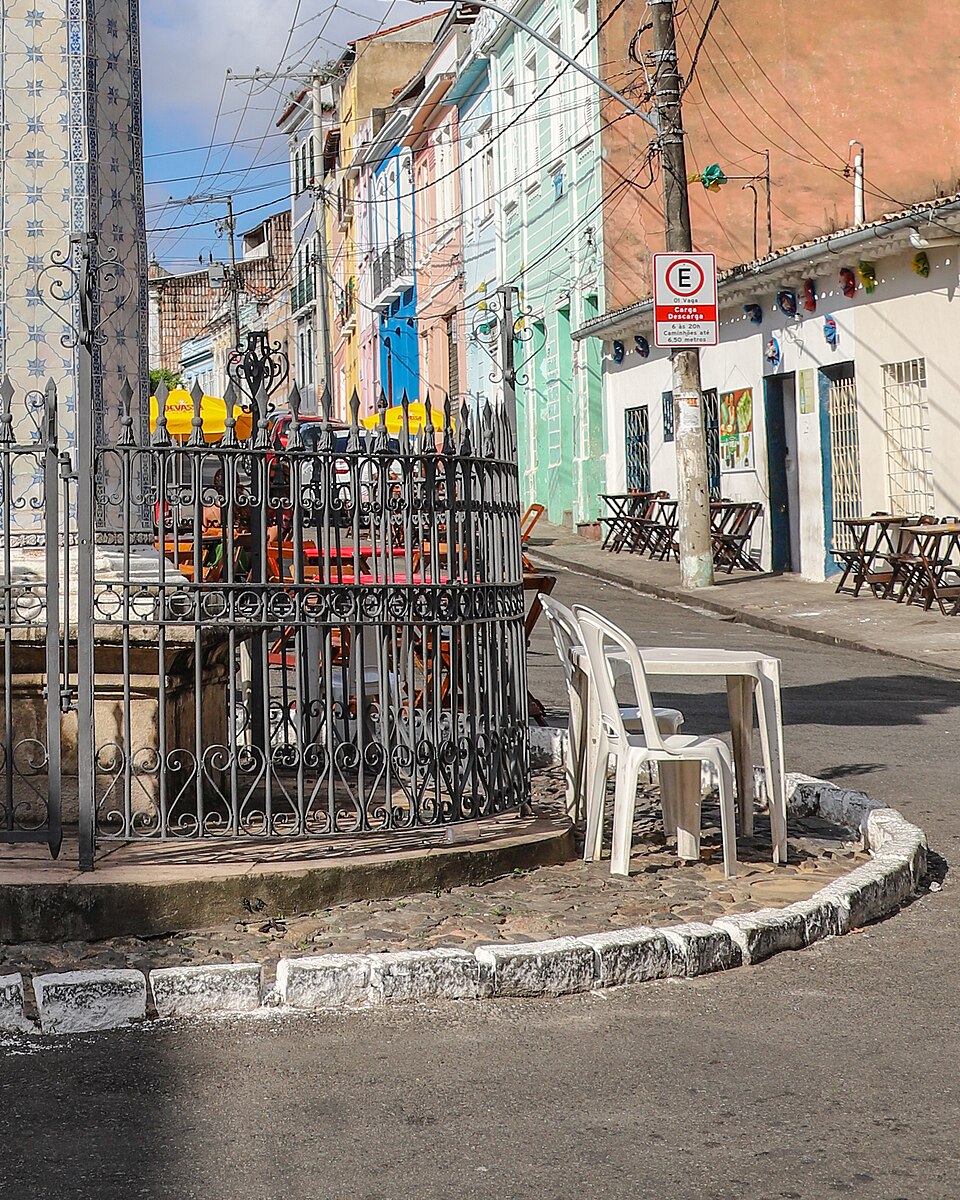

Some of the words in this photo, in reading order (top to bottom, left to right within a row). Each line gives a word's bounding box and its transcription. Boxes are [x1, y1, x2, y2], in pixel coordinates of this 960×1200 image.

[678, 268, 691, 288] E
[674, 306, 698, 314] Carga
[668, 313, 704, 321] Descarga
